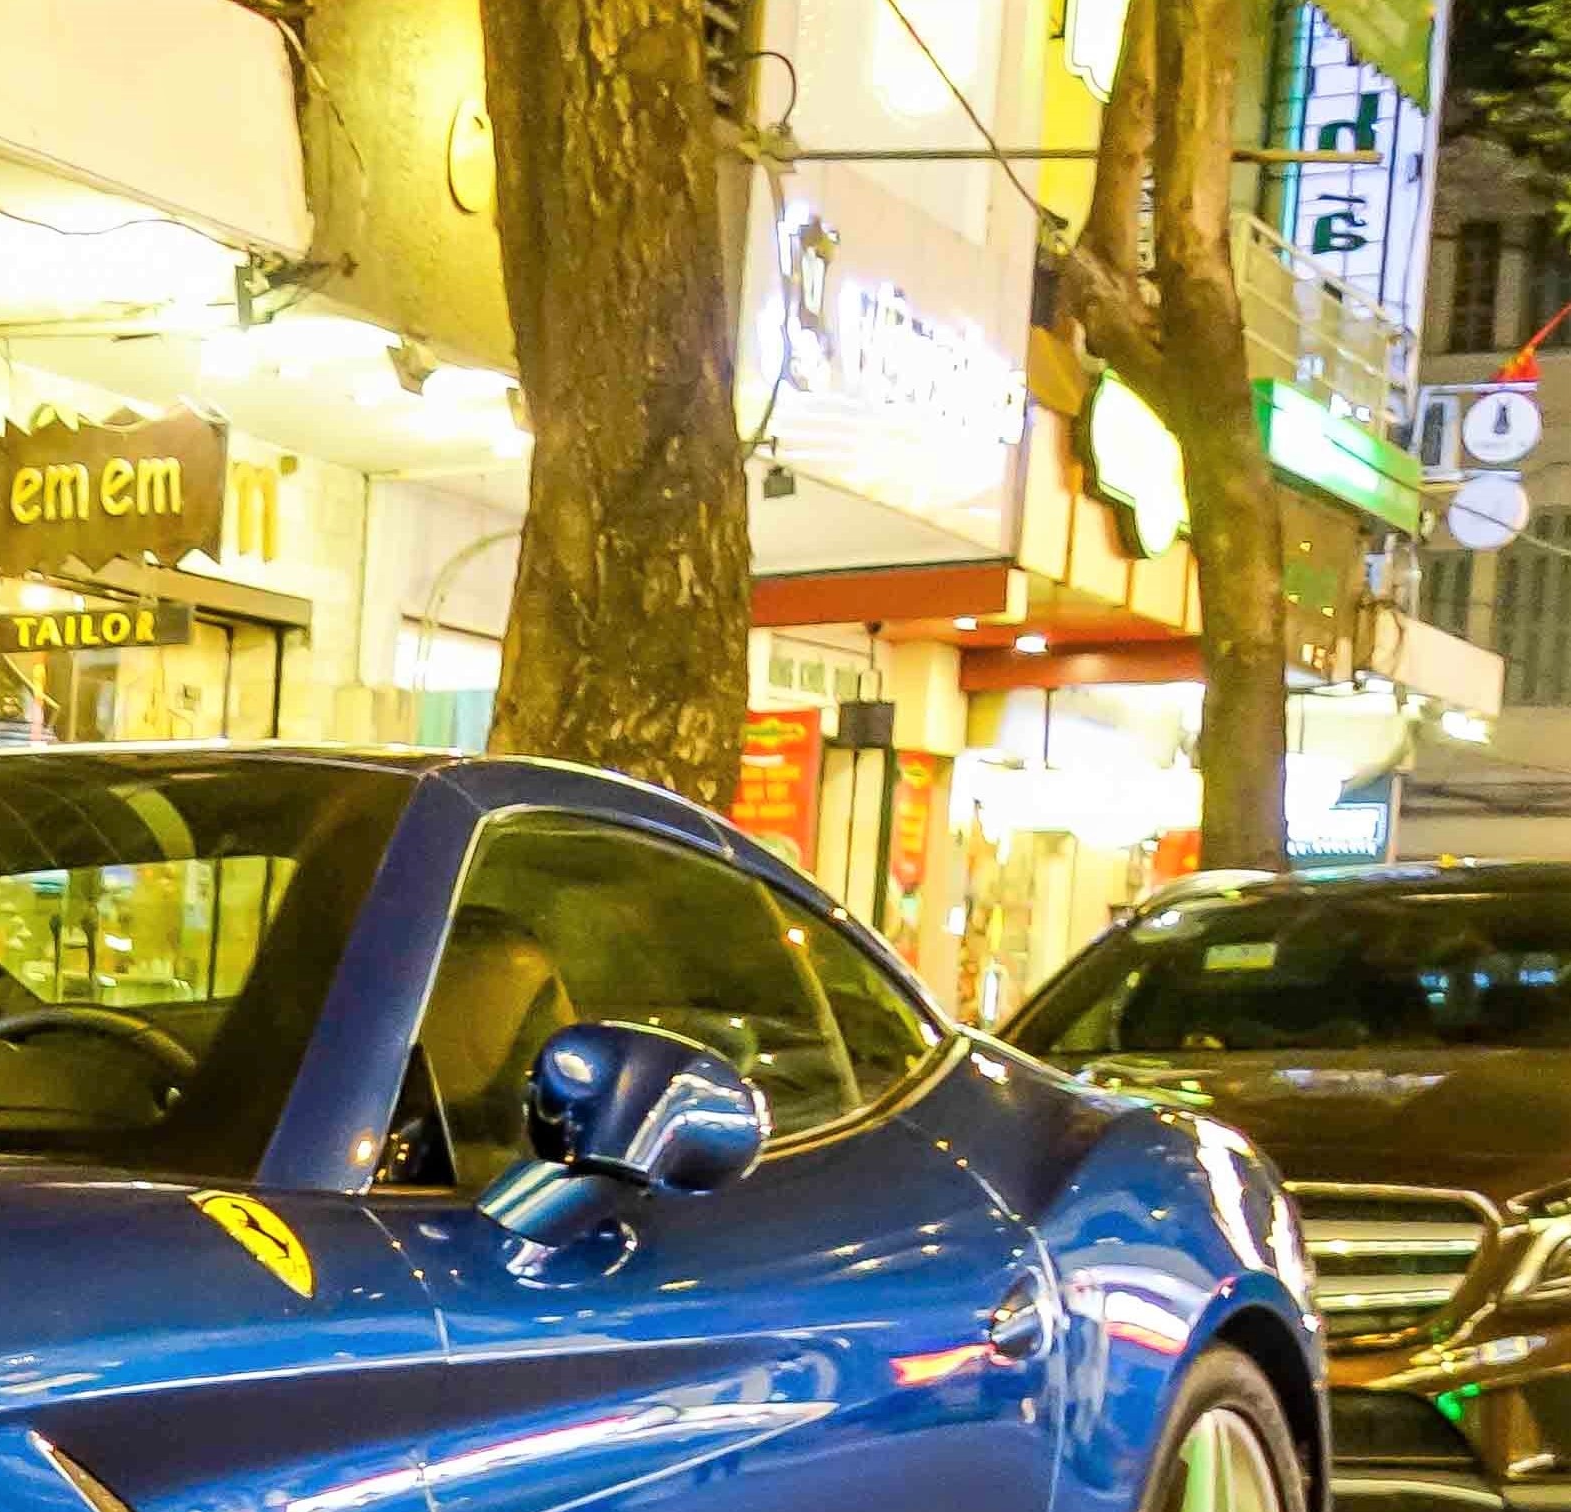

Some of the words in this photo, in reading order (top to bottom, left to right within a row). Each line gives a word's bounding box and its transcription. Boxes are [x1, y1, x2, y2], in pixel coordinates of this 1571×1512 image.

[10, 463, 91, 525] em
[99, 453, 184, 518] em
[13, 612, 157, 648] TAILOR
